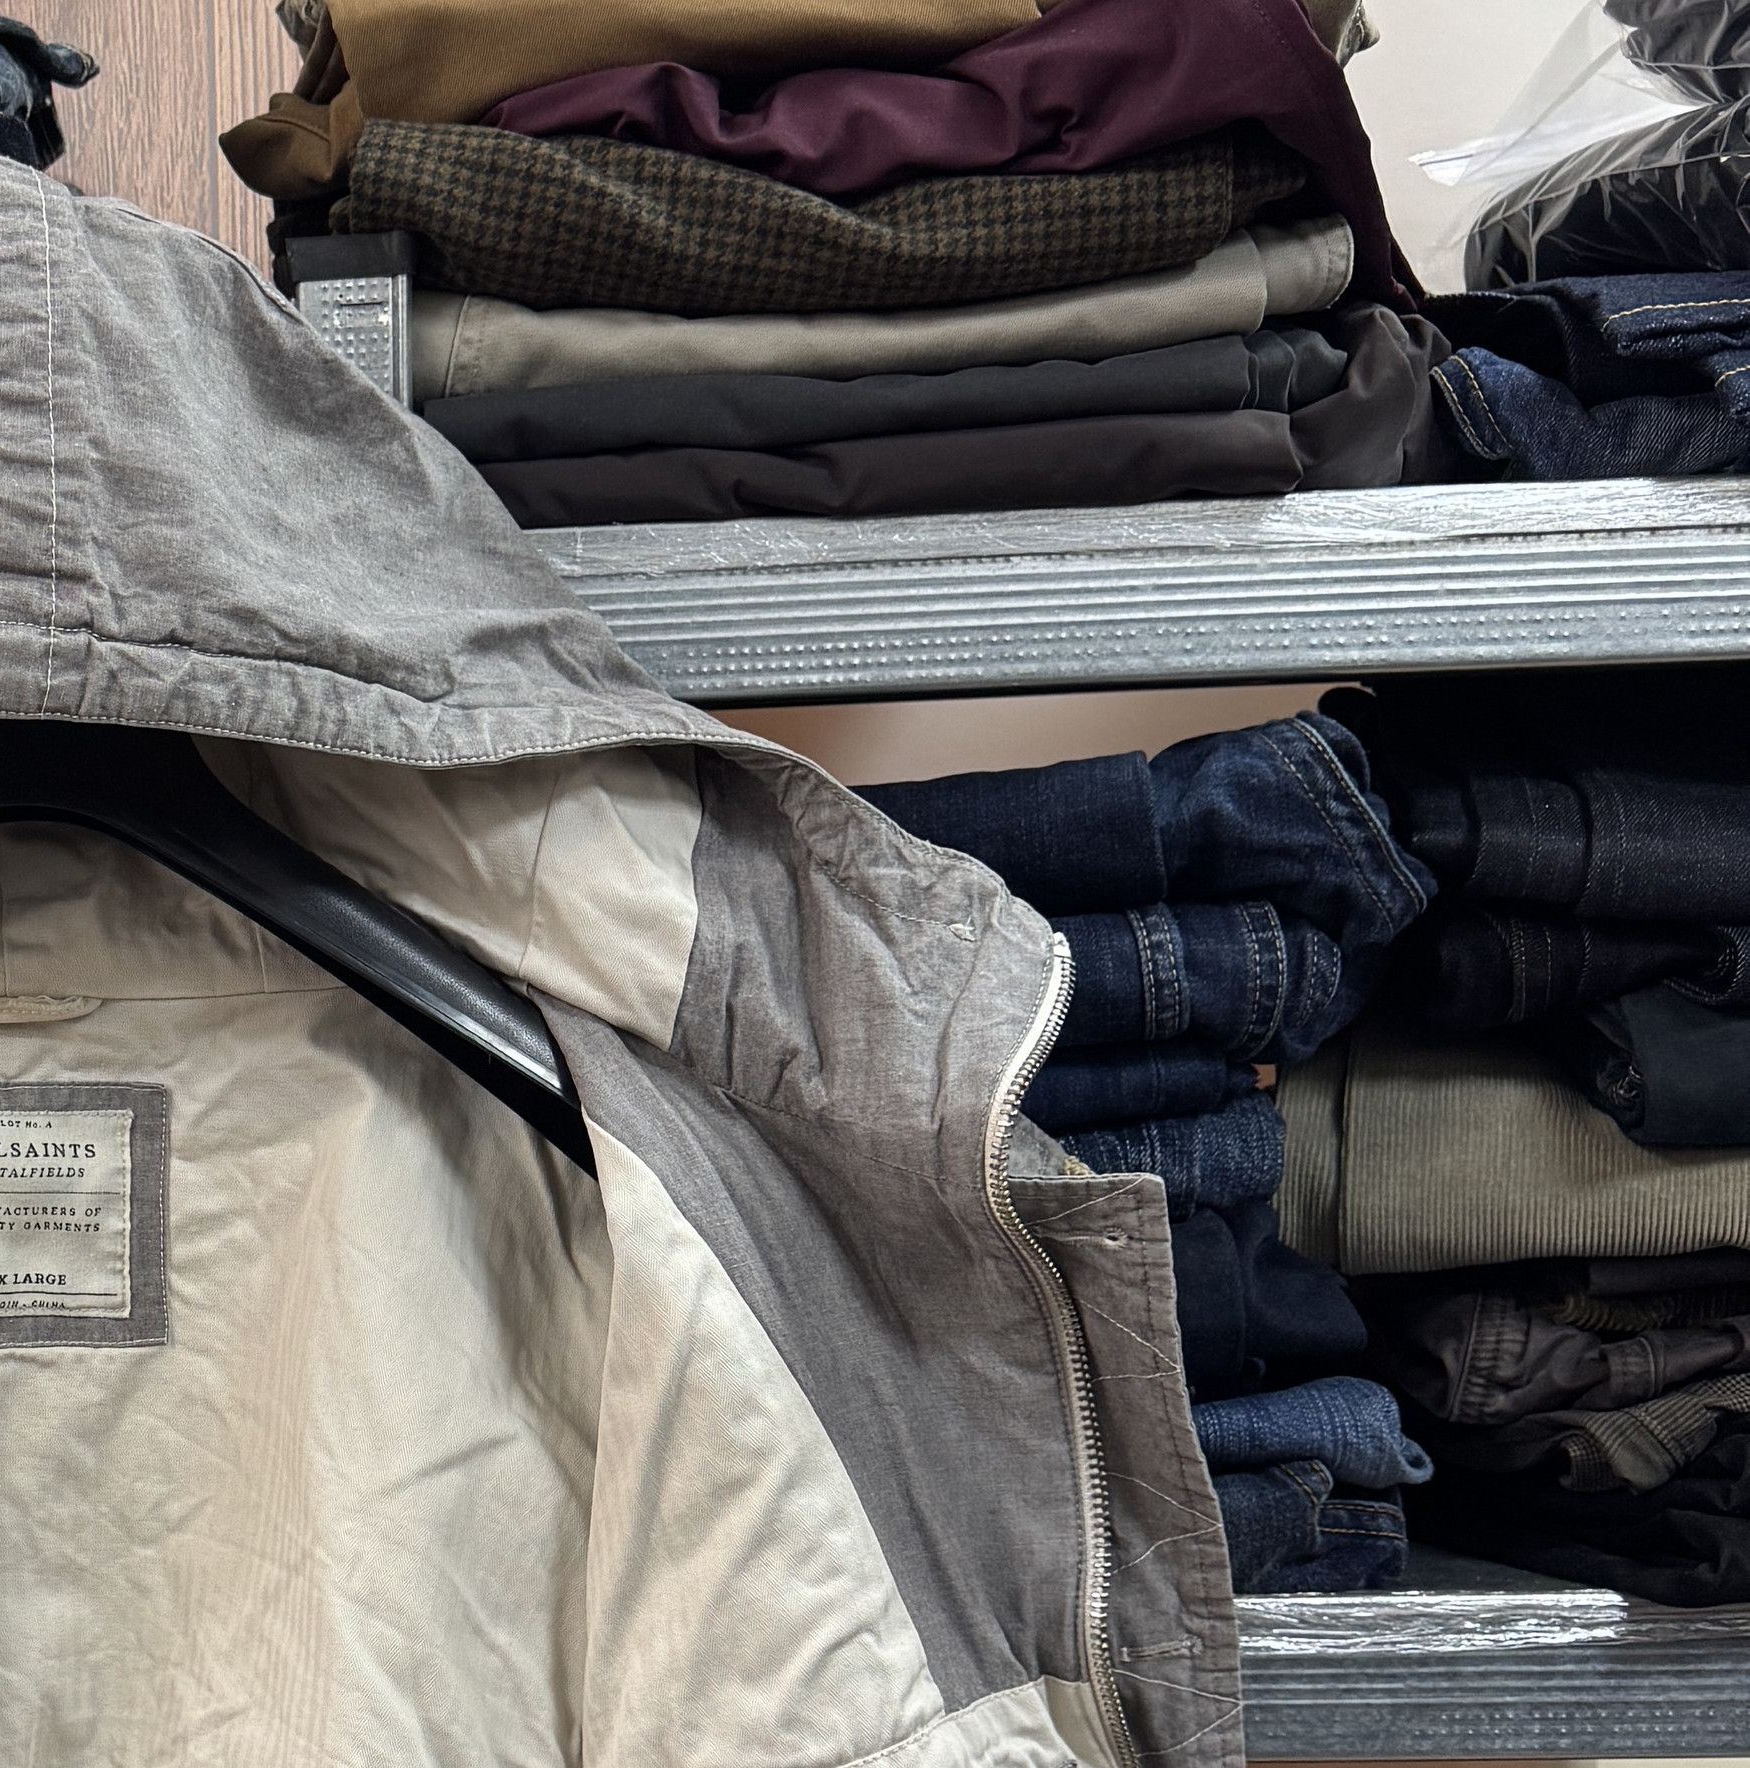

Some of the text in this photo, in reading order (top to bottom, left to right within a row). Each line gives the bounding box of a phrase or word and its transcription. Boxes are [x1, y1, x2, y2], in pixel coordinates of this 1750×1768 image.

[84, 1207, 102, 1217] OF
[24, 1221, 101, 1232] GARMENTS
[12, 1273, 67, 1285] LARGE
